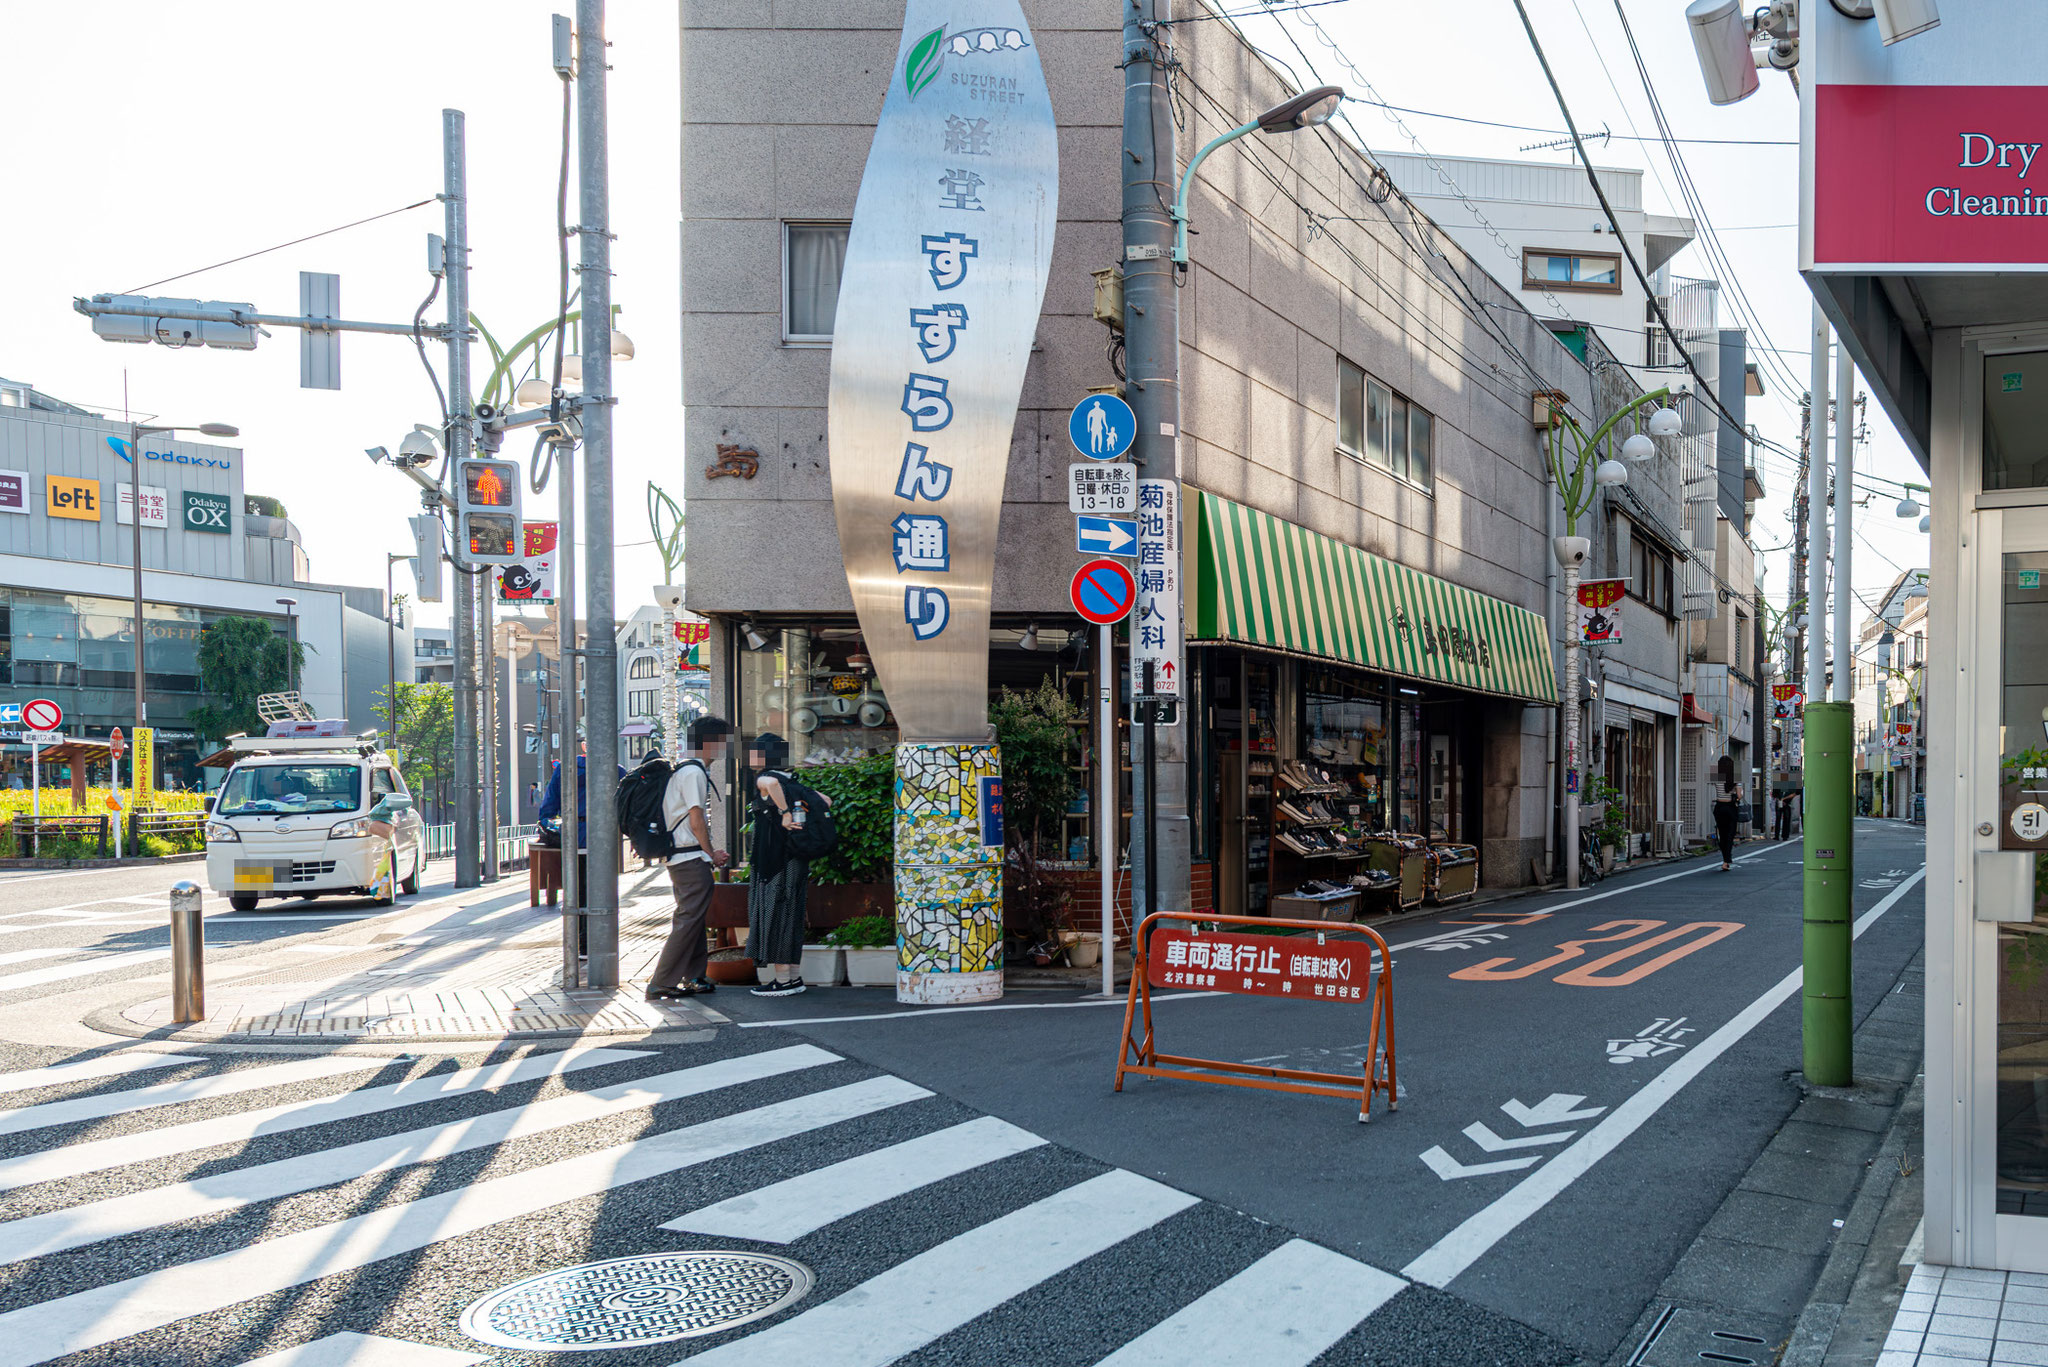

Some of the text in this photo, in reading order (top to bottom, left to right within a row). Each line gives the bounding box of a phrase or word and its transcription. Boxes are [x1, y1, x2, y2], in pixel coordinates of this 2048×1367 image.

[951, 73, 1017, 90] SUZURAN
[970, 88, 1025, 105] STREET
[1958, 132, 2042, 178] Dry
[891, 113, 991, 641] 経堂 すずらん通り
[145, 450, 230, 469] odakyu
[1075, 468, 1130, 481] 自転車を除く
[1077, 483, 1129, 495] 日曜・休日の
[189, 496, 226, 512] Odakyu
[187, 507, 227, 528] OX
[1140, 484, 1166, 650] 菊池産婦人科
[837, 698, 845, 712] 1
[2023, 767, 2048, 778] 営業
[1165, 939, 1351, 981] 車両通行止 (自転車は除く)
[1164, 971, 1216, 986] 北沢警察署
[1314, 983, 1361, 999] 世田谷区
